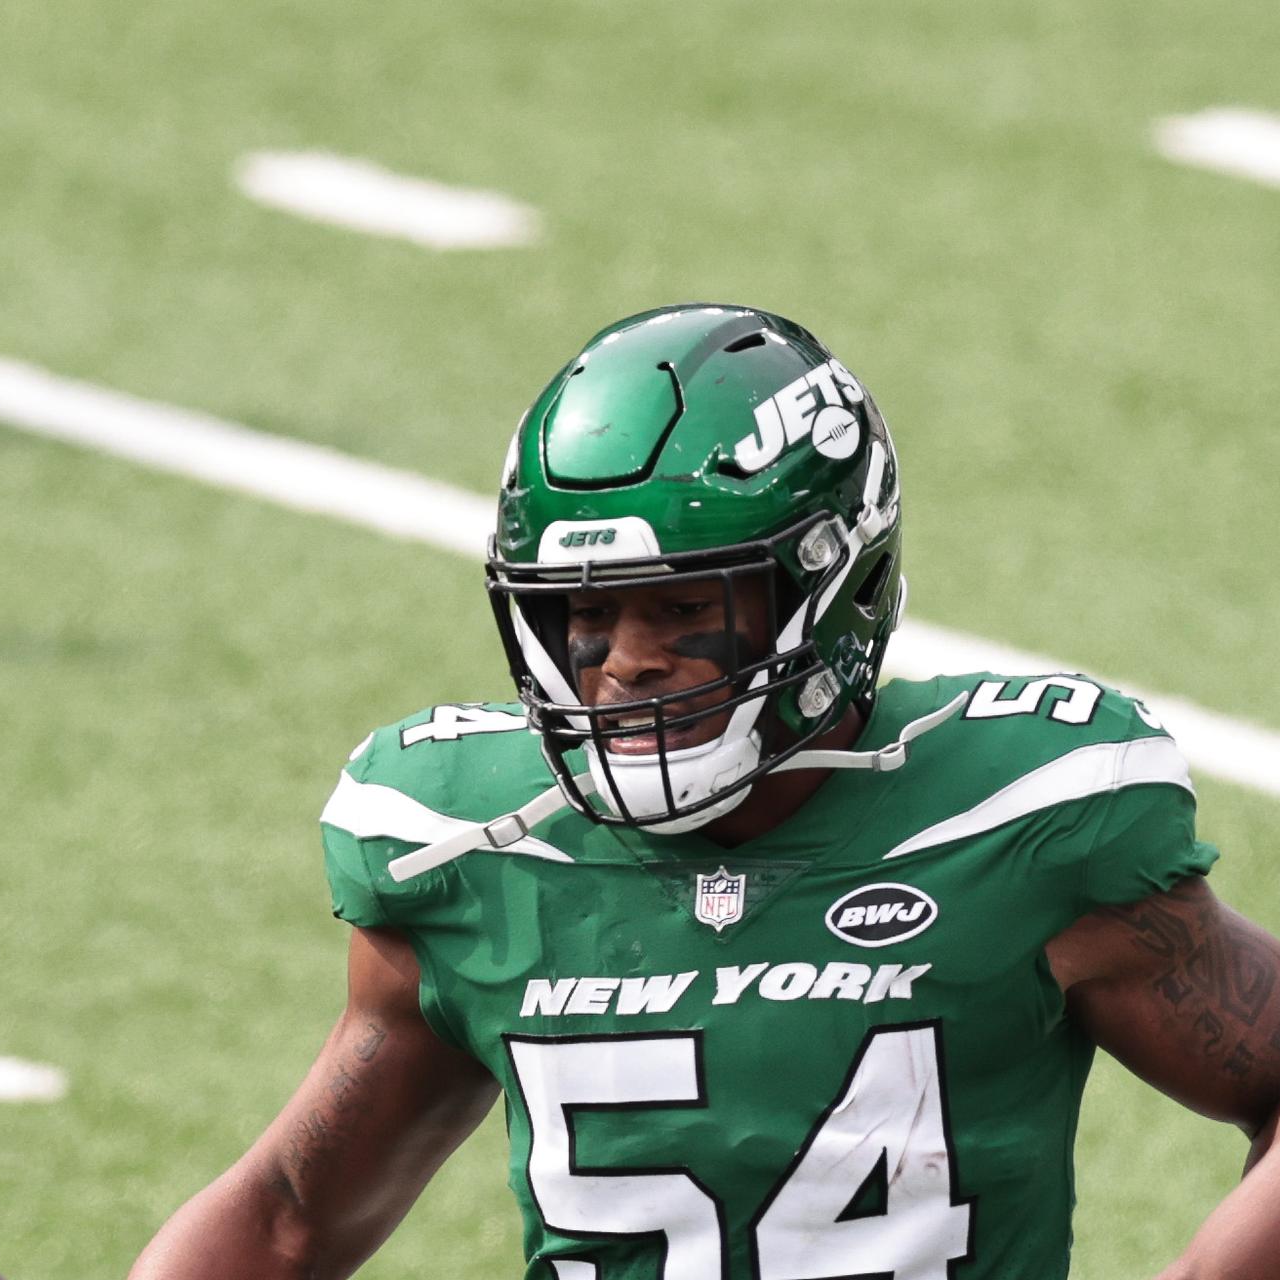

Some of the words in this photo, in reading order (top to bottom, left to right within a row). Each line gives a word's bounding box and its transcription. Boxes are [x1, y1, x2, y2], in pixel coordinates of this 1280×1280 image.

[734, 357, 864, 473] JETS
[559, 528, 616, 548] JETS
[960, 672, 1106, 727] 5
[400, 702, 530, 750] 4
[837, 901, 927, 928] BWJ
[520, 971, 699, 1017] NEW
[712, 962, 932, 1005] YORK
